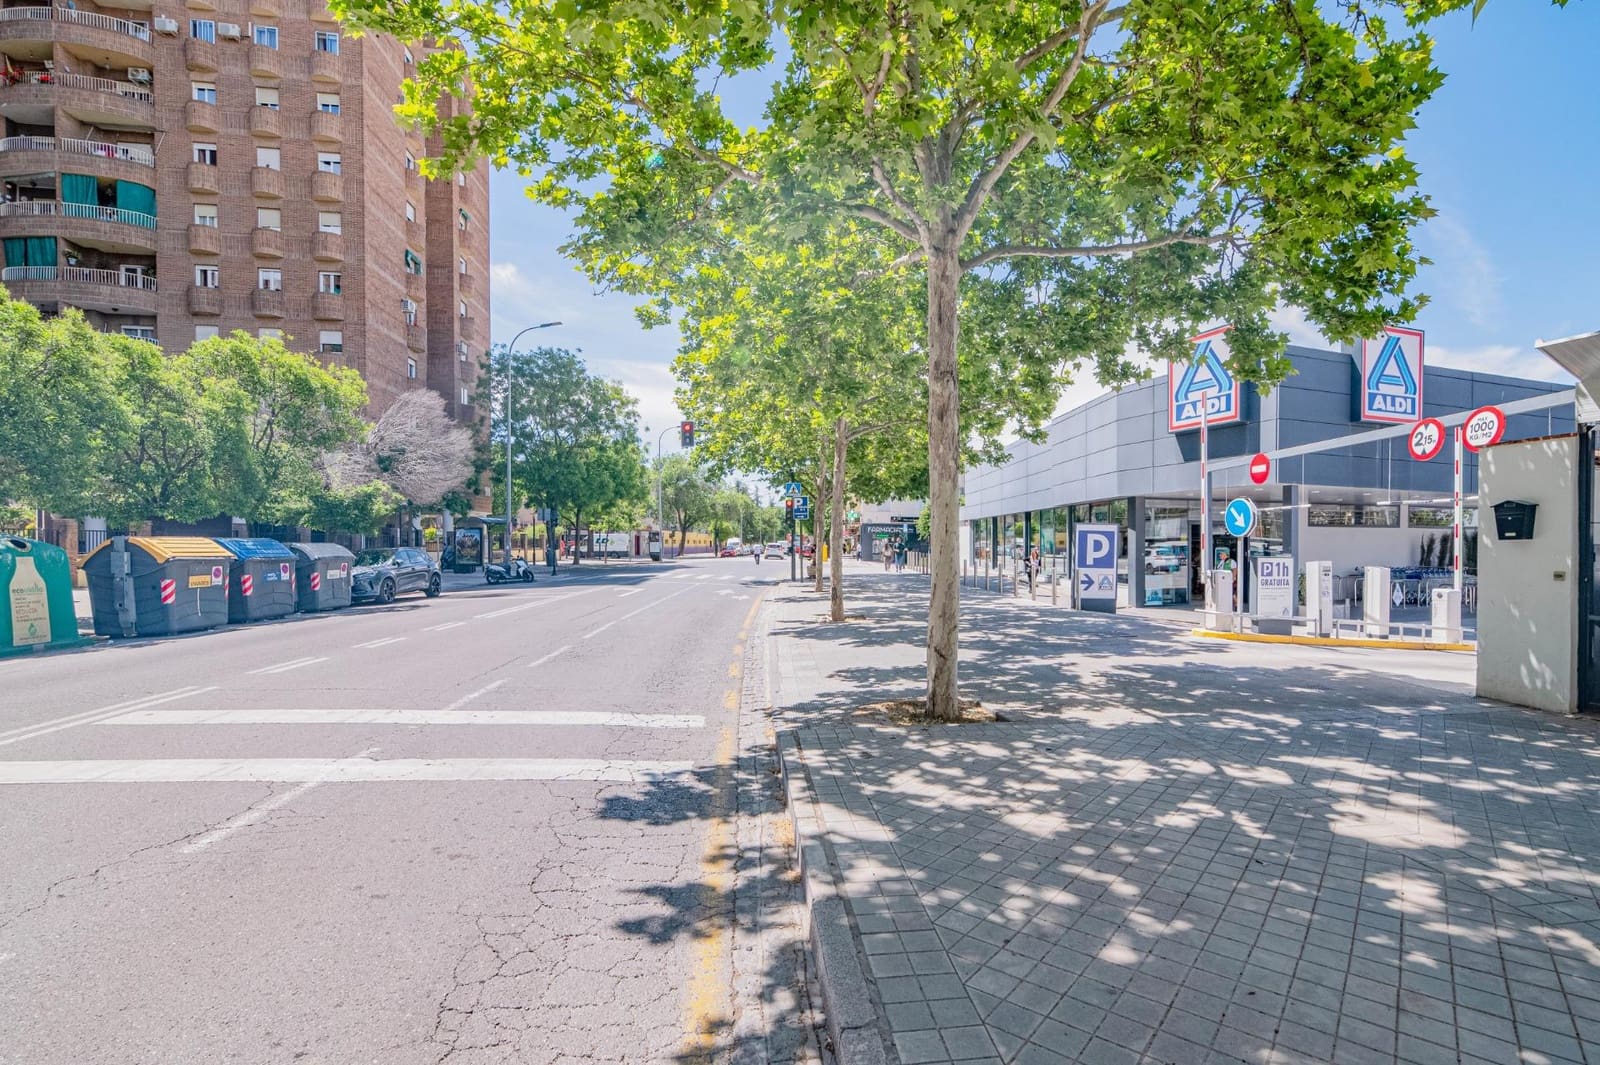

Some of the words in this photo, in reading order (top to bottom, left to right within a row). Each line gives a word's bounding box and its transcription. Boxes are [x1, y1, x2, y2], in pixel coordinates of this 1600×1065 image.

[1372, 394, 1412, 413] ALDI
[1470, 420, 1495, 434] 1000
[1086, 533, 1110, 565] P
[1275, 562, 1289, 577] 1h
